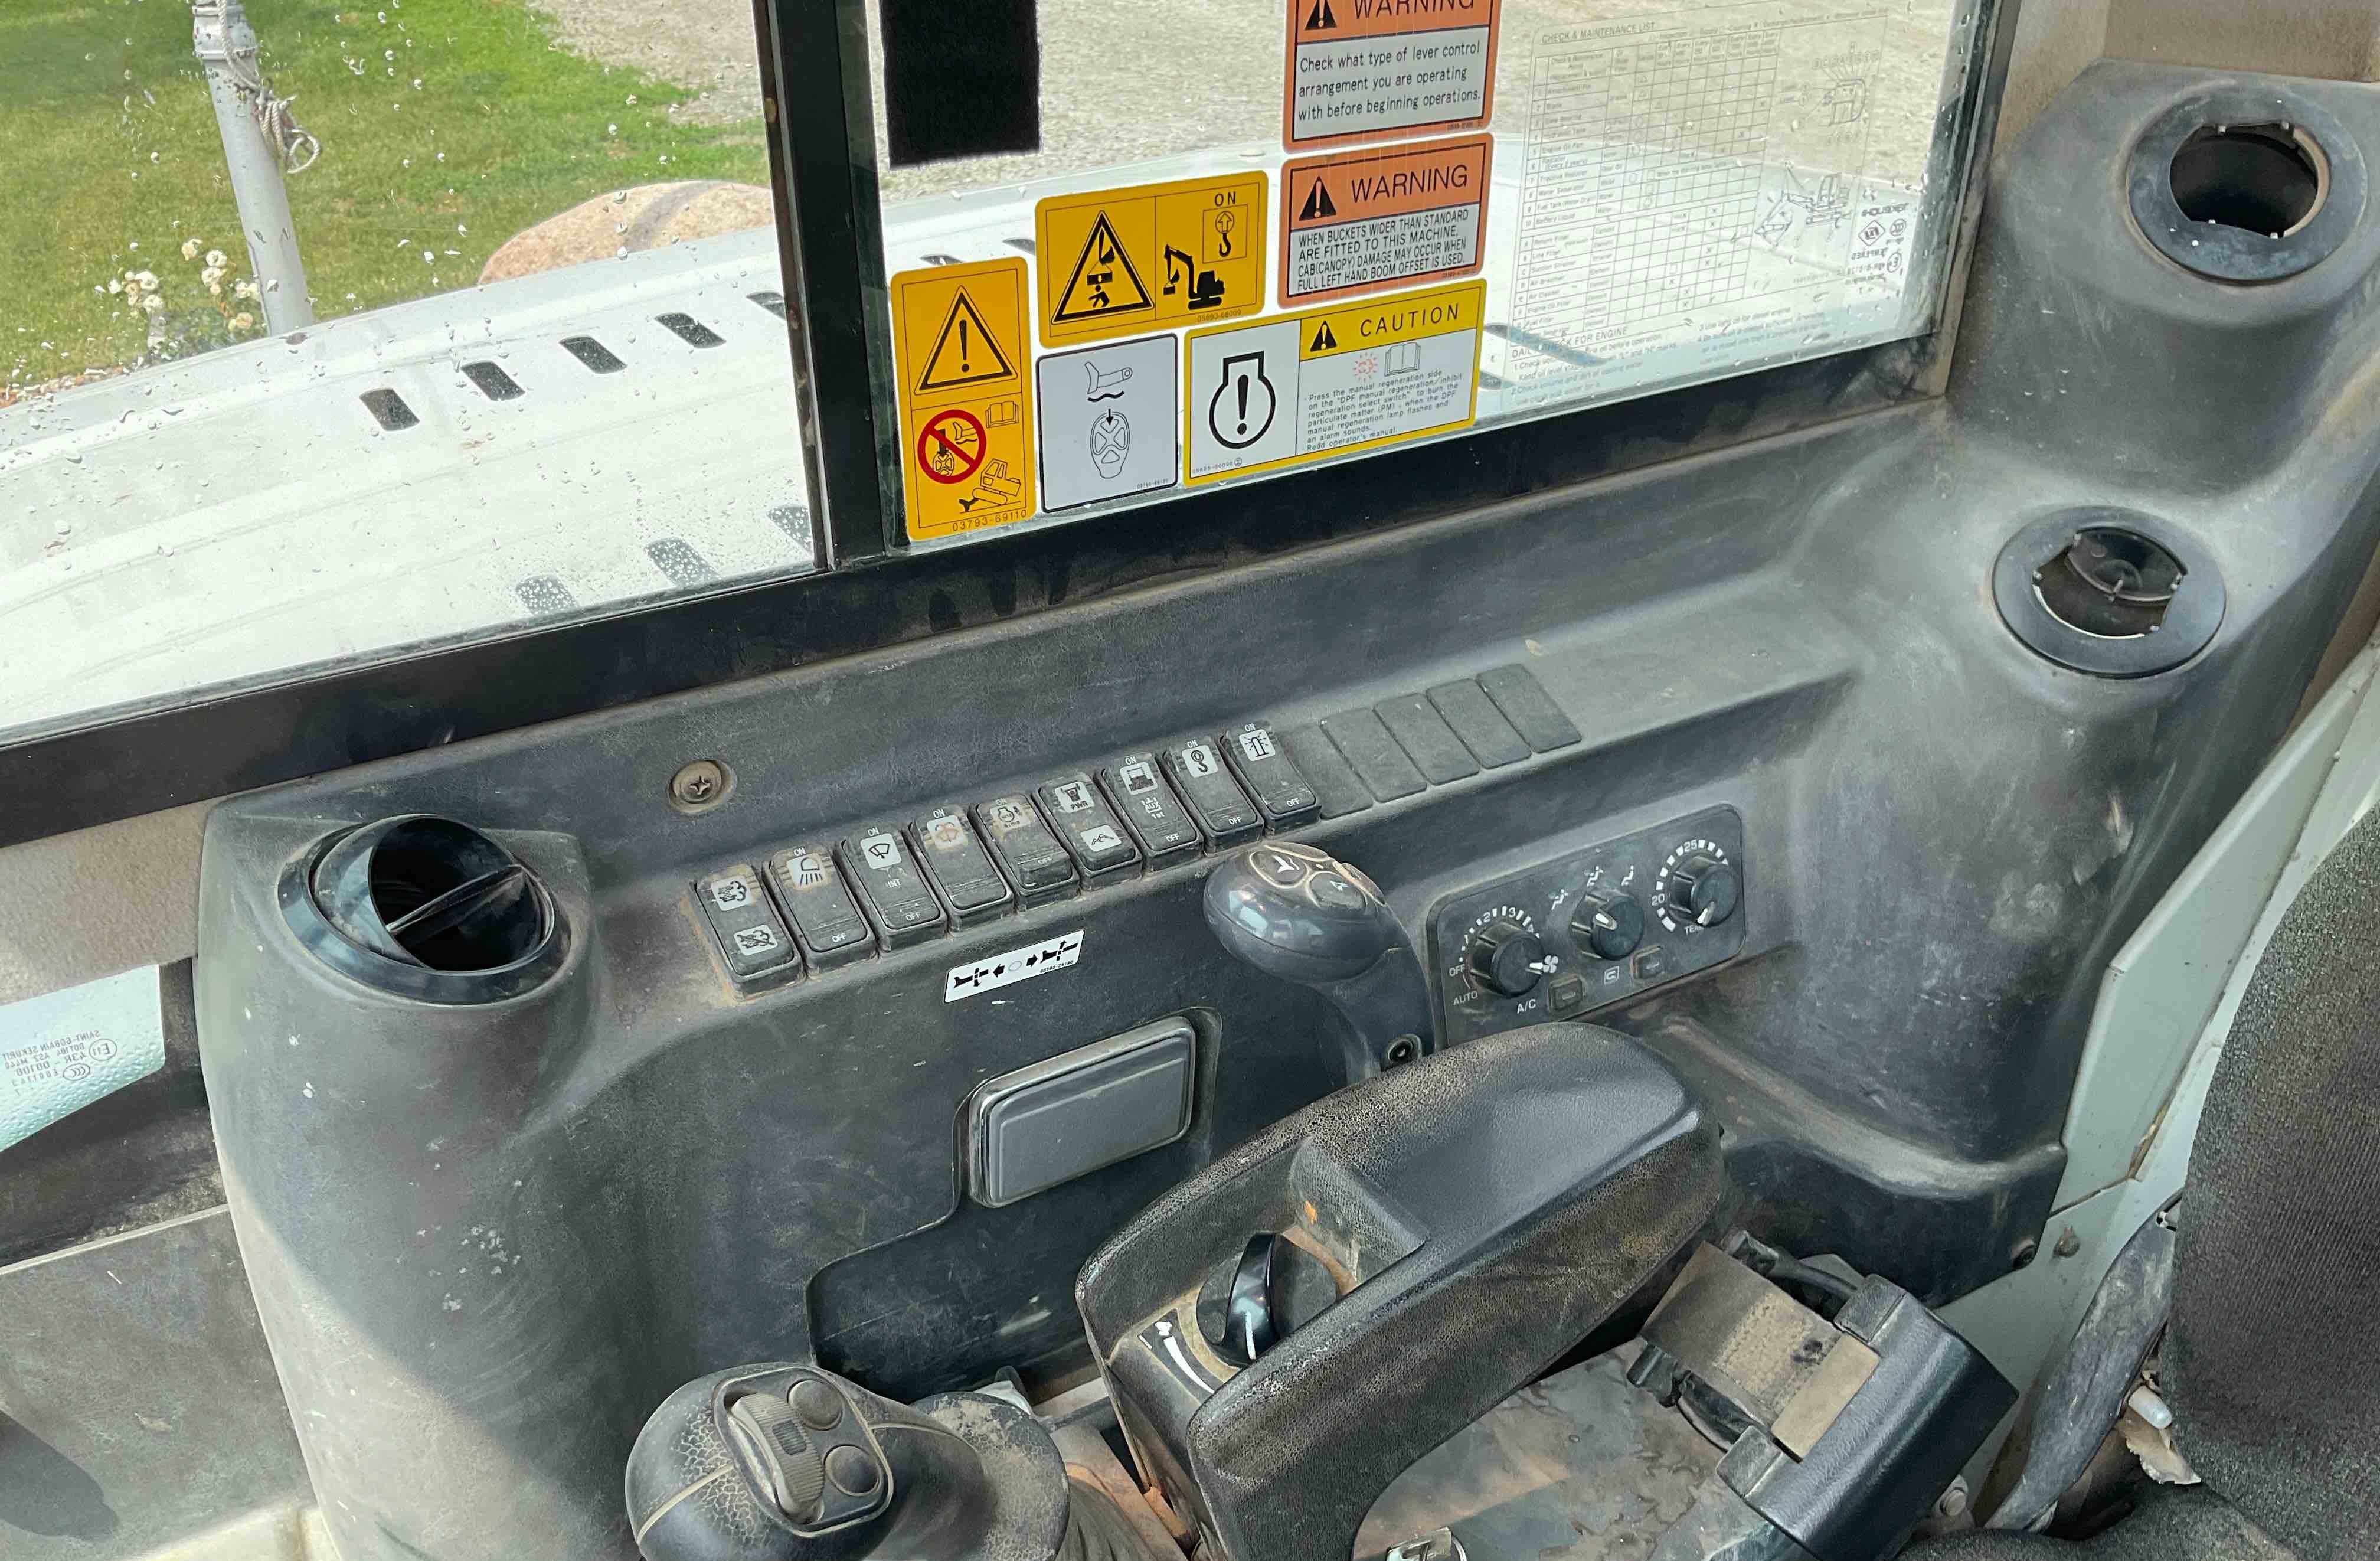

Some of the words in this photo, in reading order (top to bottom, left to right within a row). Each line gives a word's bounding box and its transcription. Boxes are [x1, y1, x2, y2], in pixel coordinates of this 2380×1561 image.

[1542, 32, 1569, 43] CHECK
[1581, 25, 1637, 38] MAINTENANCE
[1639, 22, 1655, 34] LIST
[1300, 55, 1332, 72] Check
[1338, 54, 1364, 68] what
[1369, 51, 1391, 65] type
[1397, 48, 1407, 61] of
[1413, 47, 1438, 60] lever
[1443, 40, 1479, 57] control
[1299, 79, 1368, 97] arrangement
[1373, 76, 1391, 90] you
[1395, 73, 1412, 85] are
[1417, 68, 1467, 84] operating
[1299, 105, 1322, 120] with
[1327, 101, 1362, 117] before
[1367, 94, 1418, 113] beginning
[1423, 90, 1480, 106] operations.
[1352, 165, 1467, 203] WARNING
[1214, 193, 1236, 207] ON
[1299, 233, 1325, 247] WHEN
[1327, 226, 1366, 243] BUCKETS
[1369, 221, 1395, 236] WIDER
[1400, 217, 1421, 230] THAN
[1424, 209, 1469, 227] STANDARD
[1299, 248, 1319, 262] ARE
[1324, 241, 1360, 257] FITTED
[1365, 239, 1378, 251] TO
[1384, 234, 1405, 246] THIS
[1299, 257, 1355, 277] CAB(CANOPY)
[1358, 250, 1391, 267] DAMAGE
[1395, 247, 1411, 258] MAY
[1414, 243, 1441, 257] OCCUR
[1444, 239, 1466, 251] WHEN
[1298, 277, 1318, 291] FULL
[1322, 273, 1341, 287] LEFT
[1345, 269, 1368, 283] HAND
[1371, 265, 1395, 279] BOOM
[1398, 258, 1428, 273] OFFSET
[1432, 256, 1439, 267] IS
[1443, 253, 1464, 265] USED.
[1360, 303, 1459, 337] CAUTION
[1512, 348, 1536, 358] DAIL
[1575, 334, 1593, 345] FOR
[1596, 326, 1628, 339] ENGINE
[1349, 383, 1375, 394] manual
[1379, 373, 1424, 387] regeneration
[1428, 369, 1442, 378] side
[1359, 390, 1385, 399] manual
[1388, 373, 1462, 394] regeneration/inhibit
[1307, 414, 1347, 427] particulate
[1351, 409, 1375, 419] matter
[1405, 399, 1424, 407] when
[1427, 396, 1439, 404] the
[1441, 391, 1456, 399] DPF
[1308, 402, 1355, 419] regeneration
[1359, 397, 1380, 407] select
[1427, 386, 1444, 394] burn
[1307, 426, 1333, 435] manual
[1338, 413, 1384, 428] regeneration
[1407, 404, 1431, 414] flashes
[1436, 400, 1449, 409] and
[1307, 442, 1325, 451] Read
[1329, 435, 1366, 447] operator's
[1320, 432, 1339, 440] alarm
[953, 510, 1027, 532] 03793-69110
[1244, 723, 1256, 732] ON
[1186, 739, 1199, 749] ON
[1125, 755, 1137, 766] ON
[1070, 801, 1088, 811] PWR
[1286, 797, 1300, 808] OFF
[933, 808, 945, 819] ON
[1228, 815, 1243, 825] OFF
[868, 827, 879, 837] ON
[1166, 832, 1180, 843] OFF
[793, 846, 806, 857] ON
[1683, 841, 1698, 851] 25
[1652, 893, 1665, 905] 20
[905, 911, 921, 922] OFF
[1483, 912, 1491, 922] 2
[1508, 908, 1516, 918] 3
[832, 933, 846, 943] OFF
[1464, 935, 1469, 944] 1
[1449, 964, 1466, 978] OFF
[1453, 992, 1477, 1006] AUTO
[1516, 998, 1536, 1014] A/C
